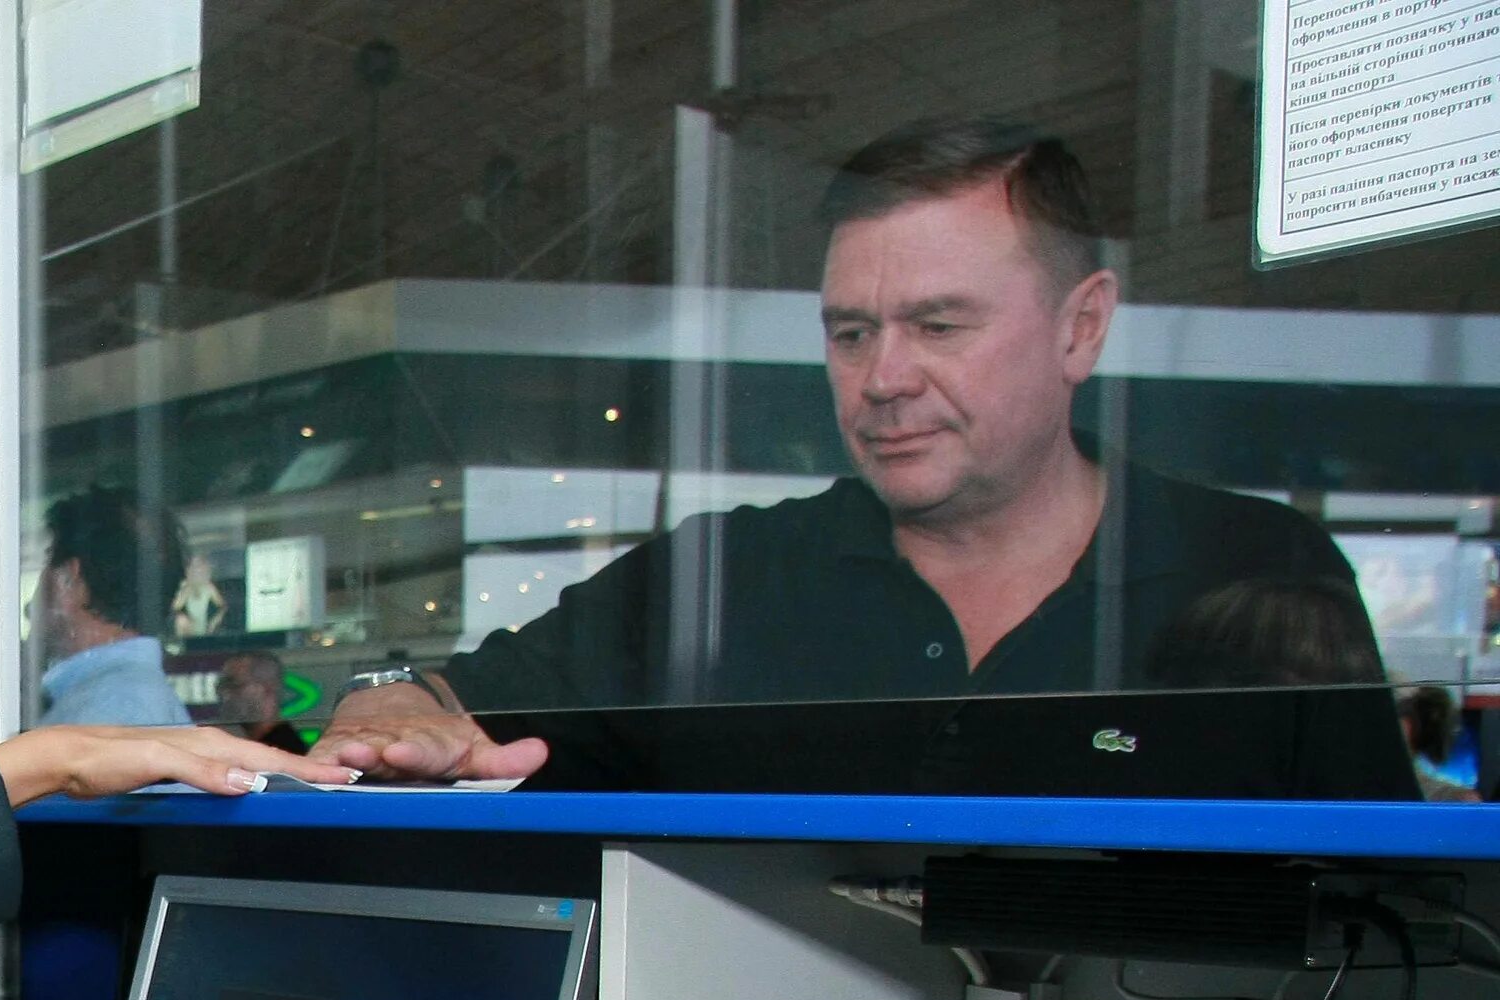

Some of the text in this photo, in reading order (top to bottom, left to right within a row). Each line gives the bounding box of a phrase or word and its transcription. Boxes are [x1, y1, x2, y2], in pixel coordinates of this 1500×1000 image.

[1291, 0, 1448, 47] оформлення в портф
[1293, 0, 1374, 29] Переносити
[1290, 80, 1306, 91] на
[1310, 63, 1361, 86] вільній
[1364, 44, 1424, 71] сторінці
[1291, 42, 1382, 74] Проставляти
[1385, 20, 1456, 48] позначку
[1459, 17, 1470, 30] у
[1289, 73, 1395, 108] кінця паспорта
[1289, 75, 1492, 135] Після перевірки документів
[1288, 94, 1492, 152] його оформлення повертати
[1288, 131, 1412, 168] паспорт власнику
[1286, 199, 1357, 221] попросити
[1360, 180, 1437, 207] вибачення
[1439, 178, 1450, 191] у
[1287, 191, 1298, 204] У
[1301, 186, 1327, 204] разі
[1330, 175, 1384, 195] падіння
[1387, 160, 1455, 183] паспорта
[1459, 154, 1478, 167] на
